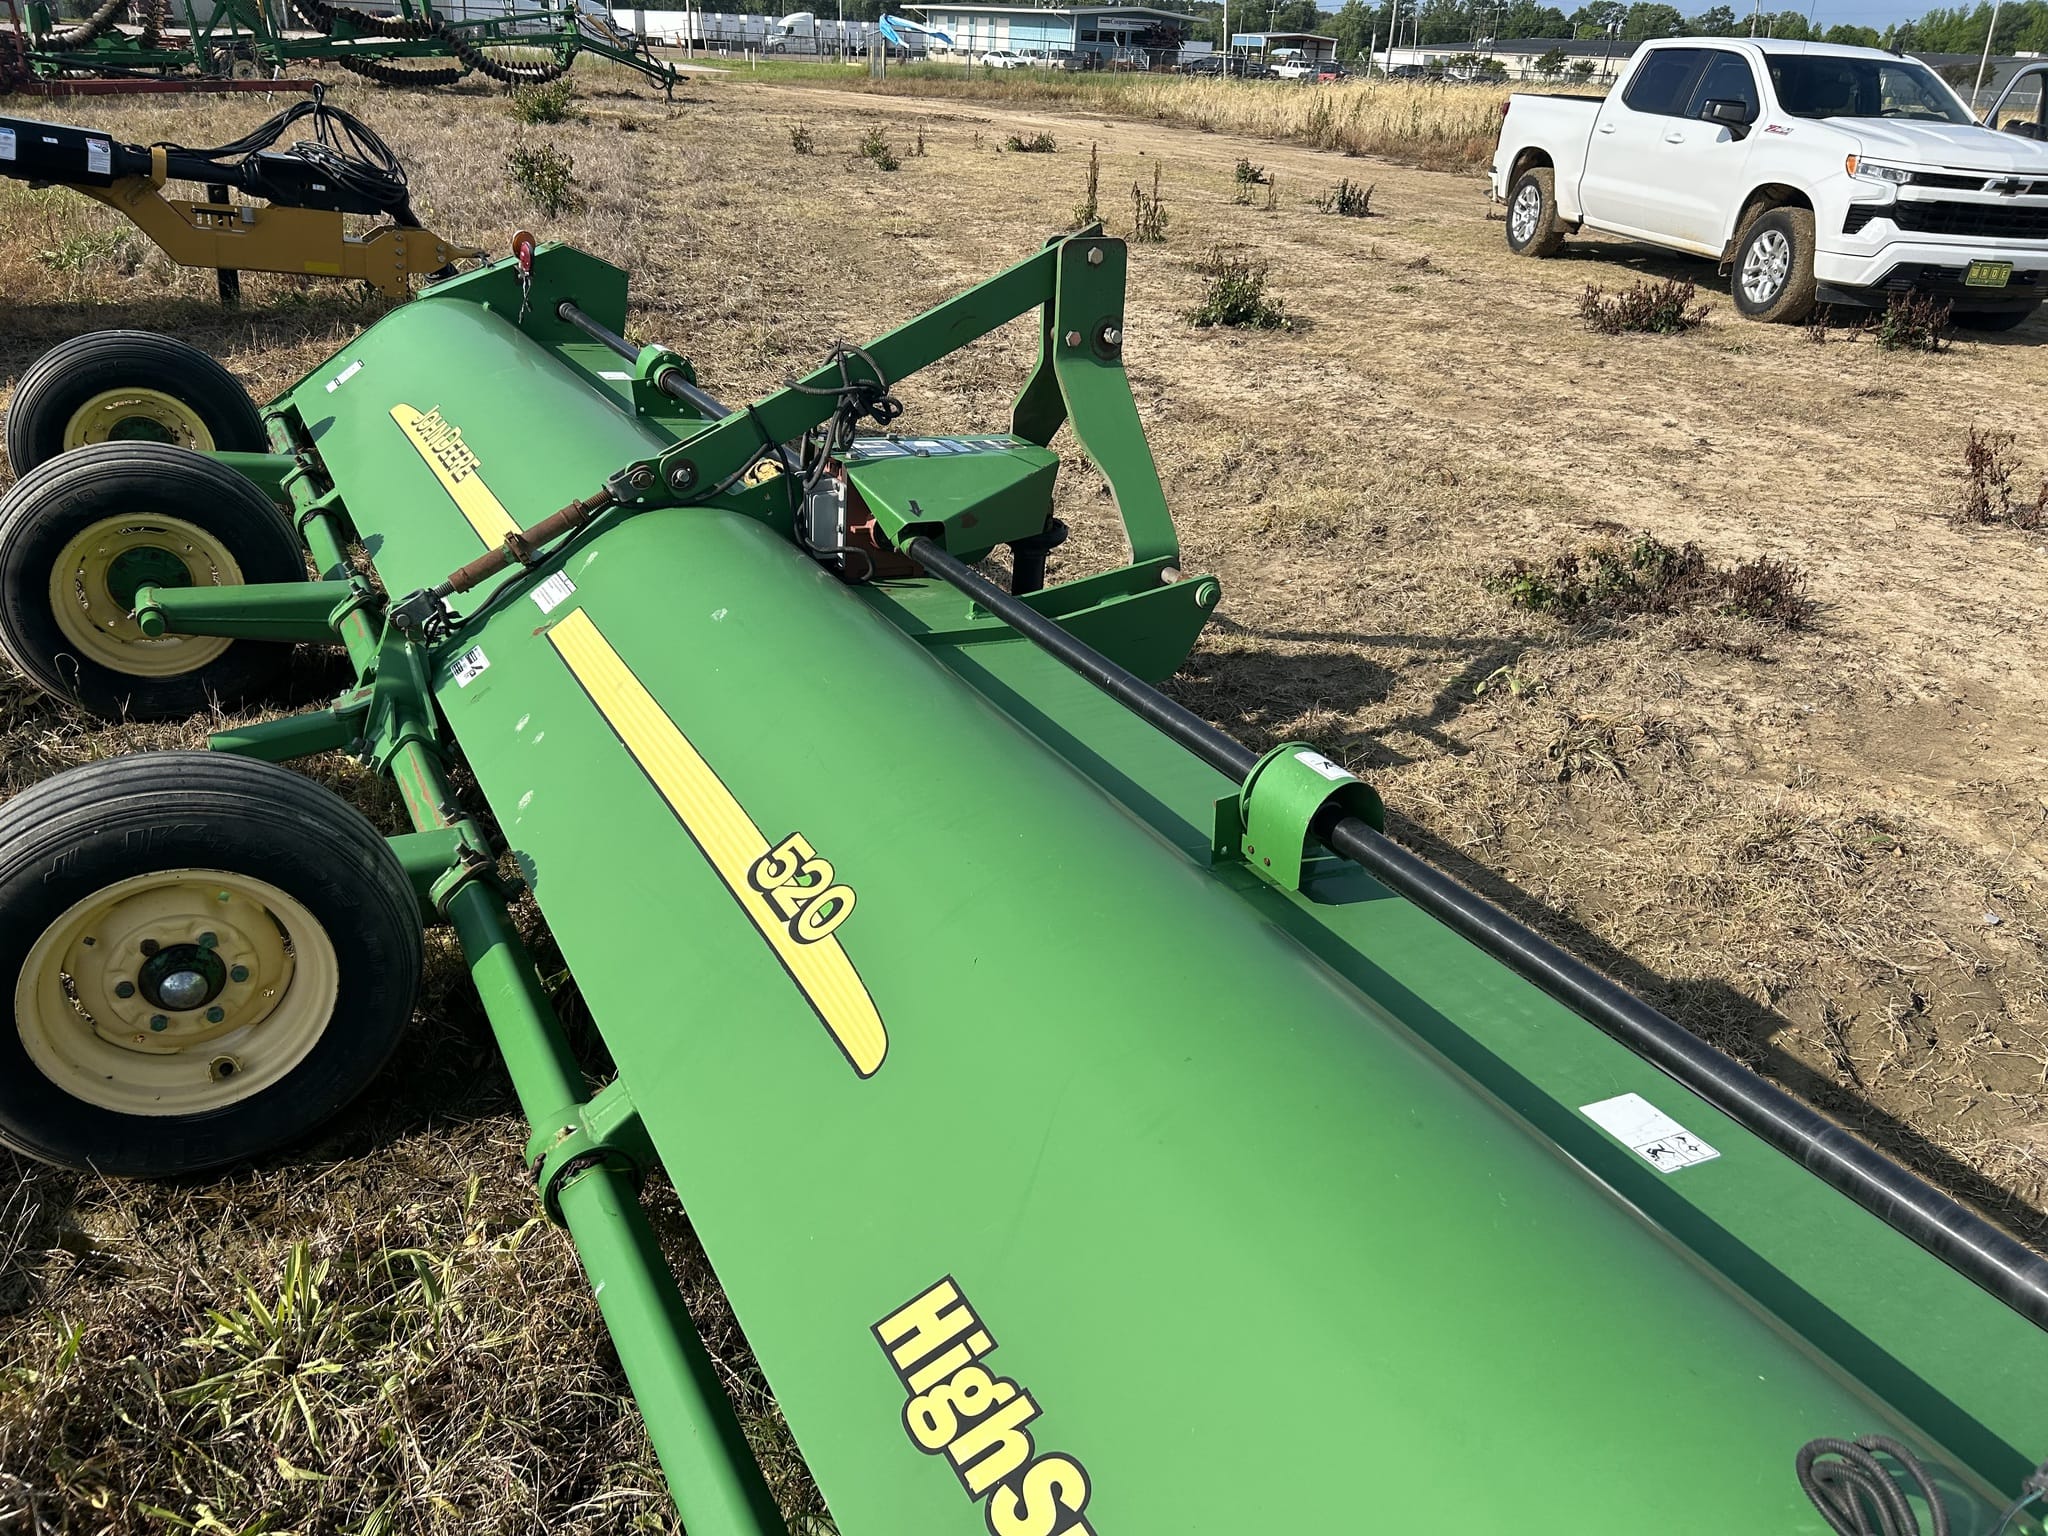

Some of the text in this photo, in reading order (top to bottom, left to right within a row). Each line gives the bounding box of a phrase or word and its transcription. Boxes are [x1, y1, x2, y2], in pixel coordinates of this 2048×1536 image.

[410, 404, 482, 484] JOHN DEERE
[747, 831, 857, 945] 520
[871, 1274, 1097, 1536] HighS
